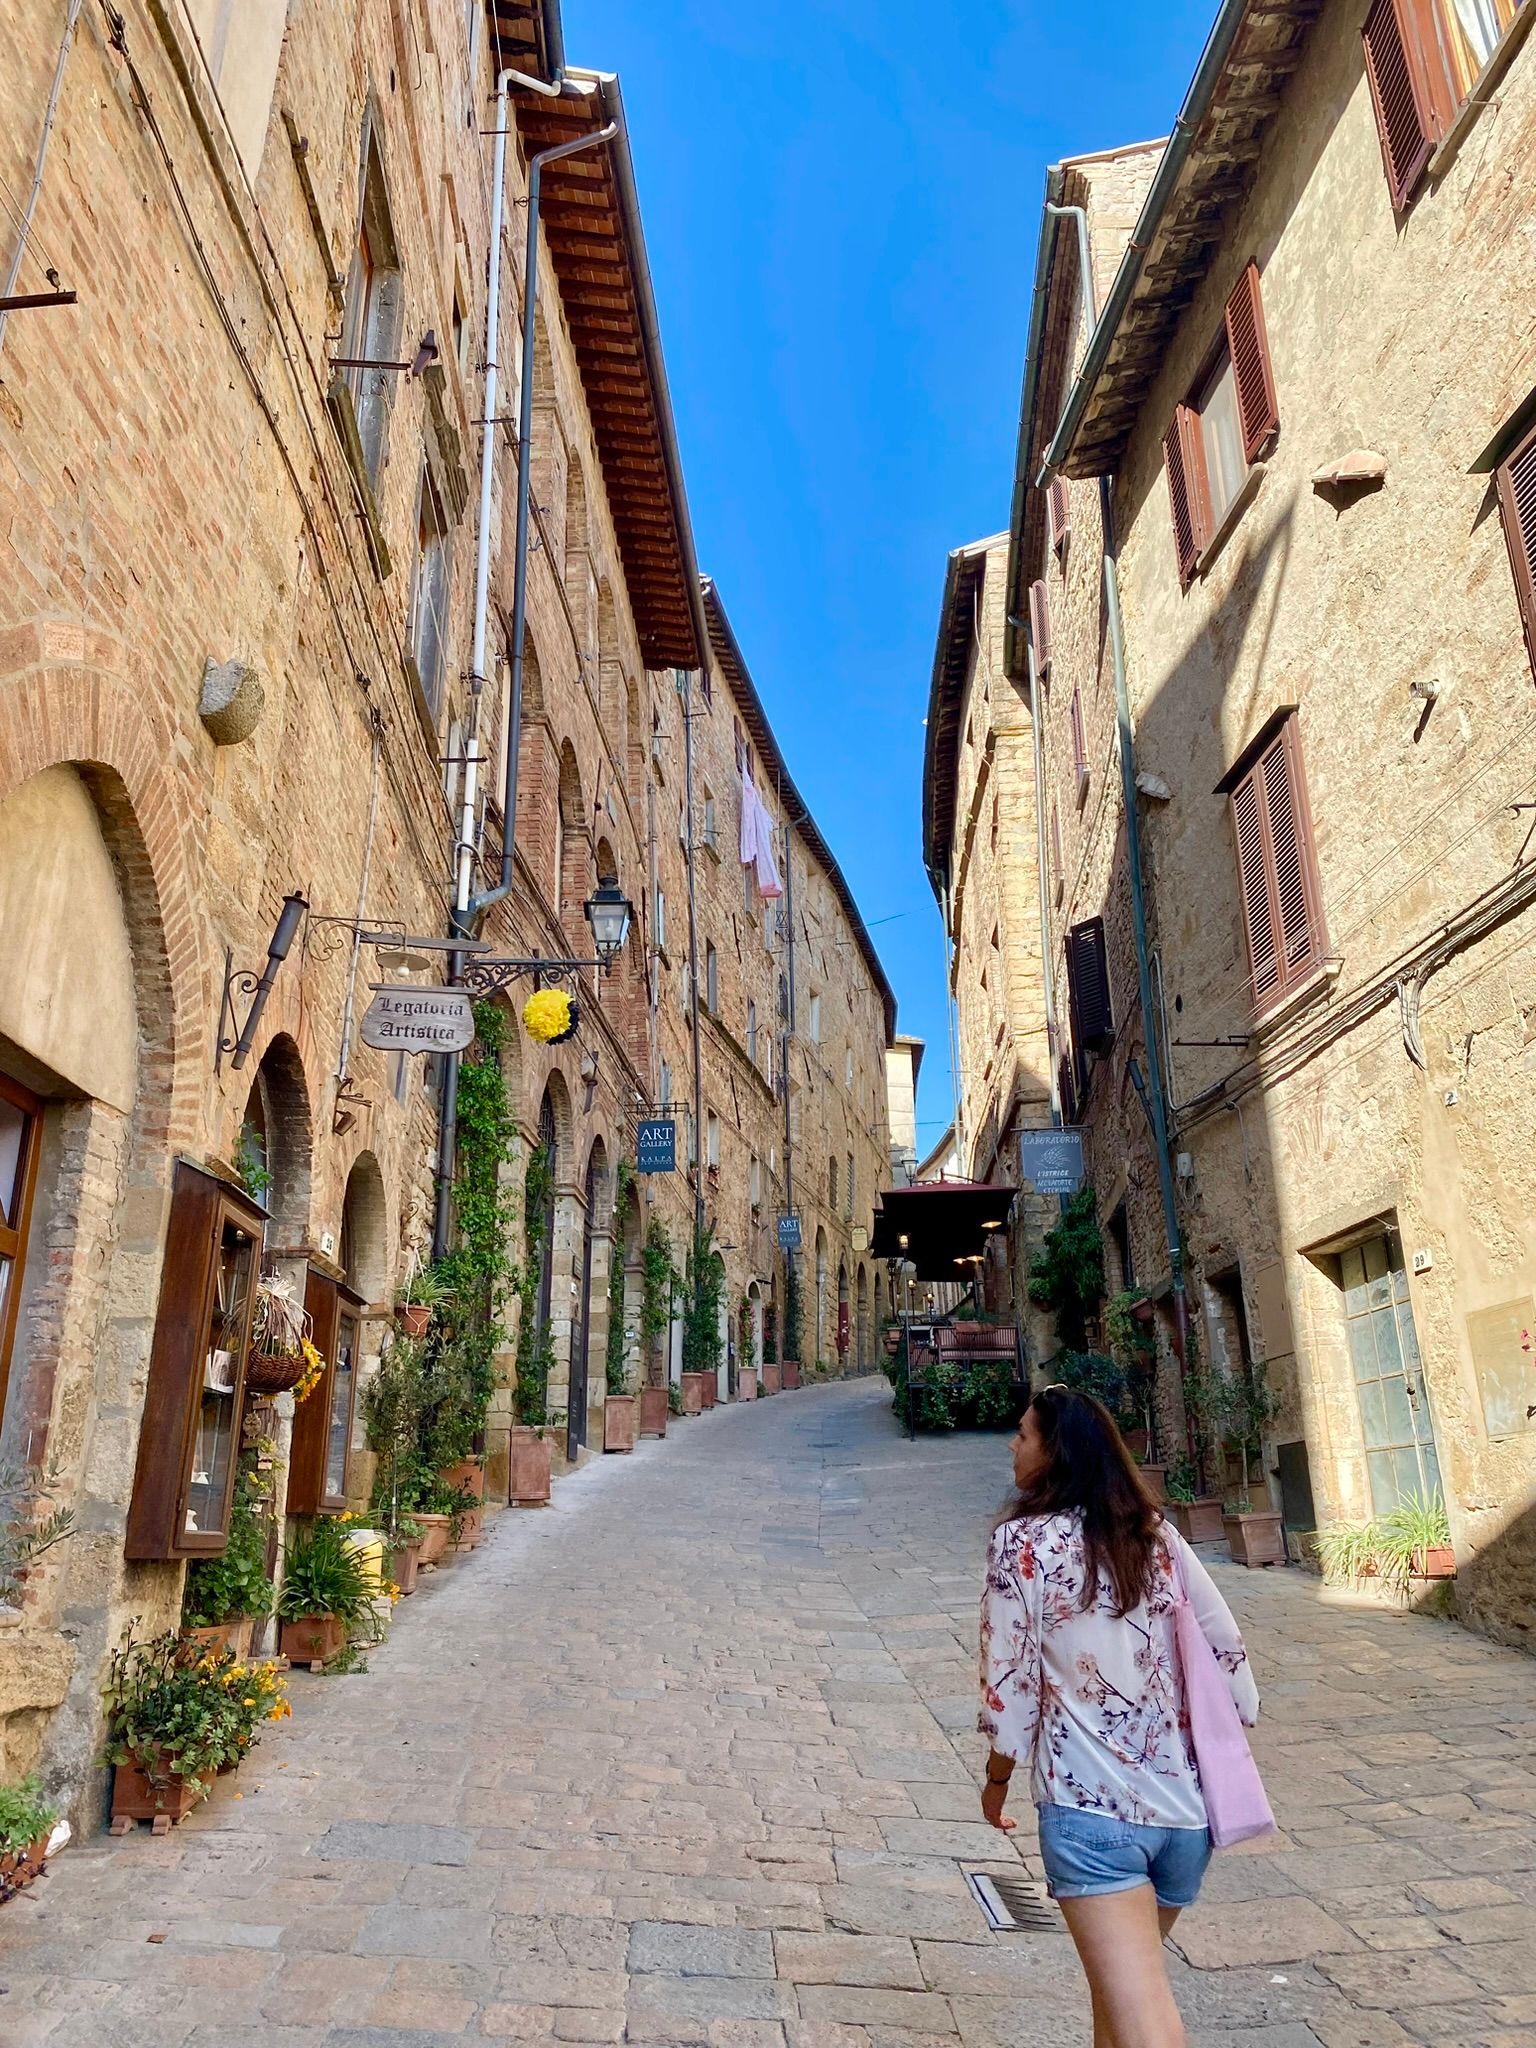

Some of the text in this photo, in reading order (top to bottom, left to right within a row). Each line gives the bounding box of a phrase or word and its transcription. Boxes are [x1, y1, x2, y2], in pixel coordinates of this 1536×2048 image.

[378, 997, 464, 1016] Legatoria
[380, 1021, 456, 1040] Artistica
[640, 1127, 673, 1141] ART
[640, 1140, 673, 1148] GALLERY
[1024, 1136, 1080, 1145] LABORATORIO
[779, 1219, 799, 1229] ART
[1415, 1255, 1424, 1267] 29
